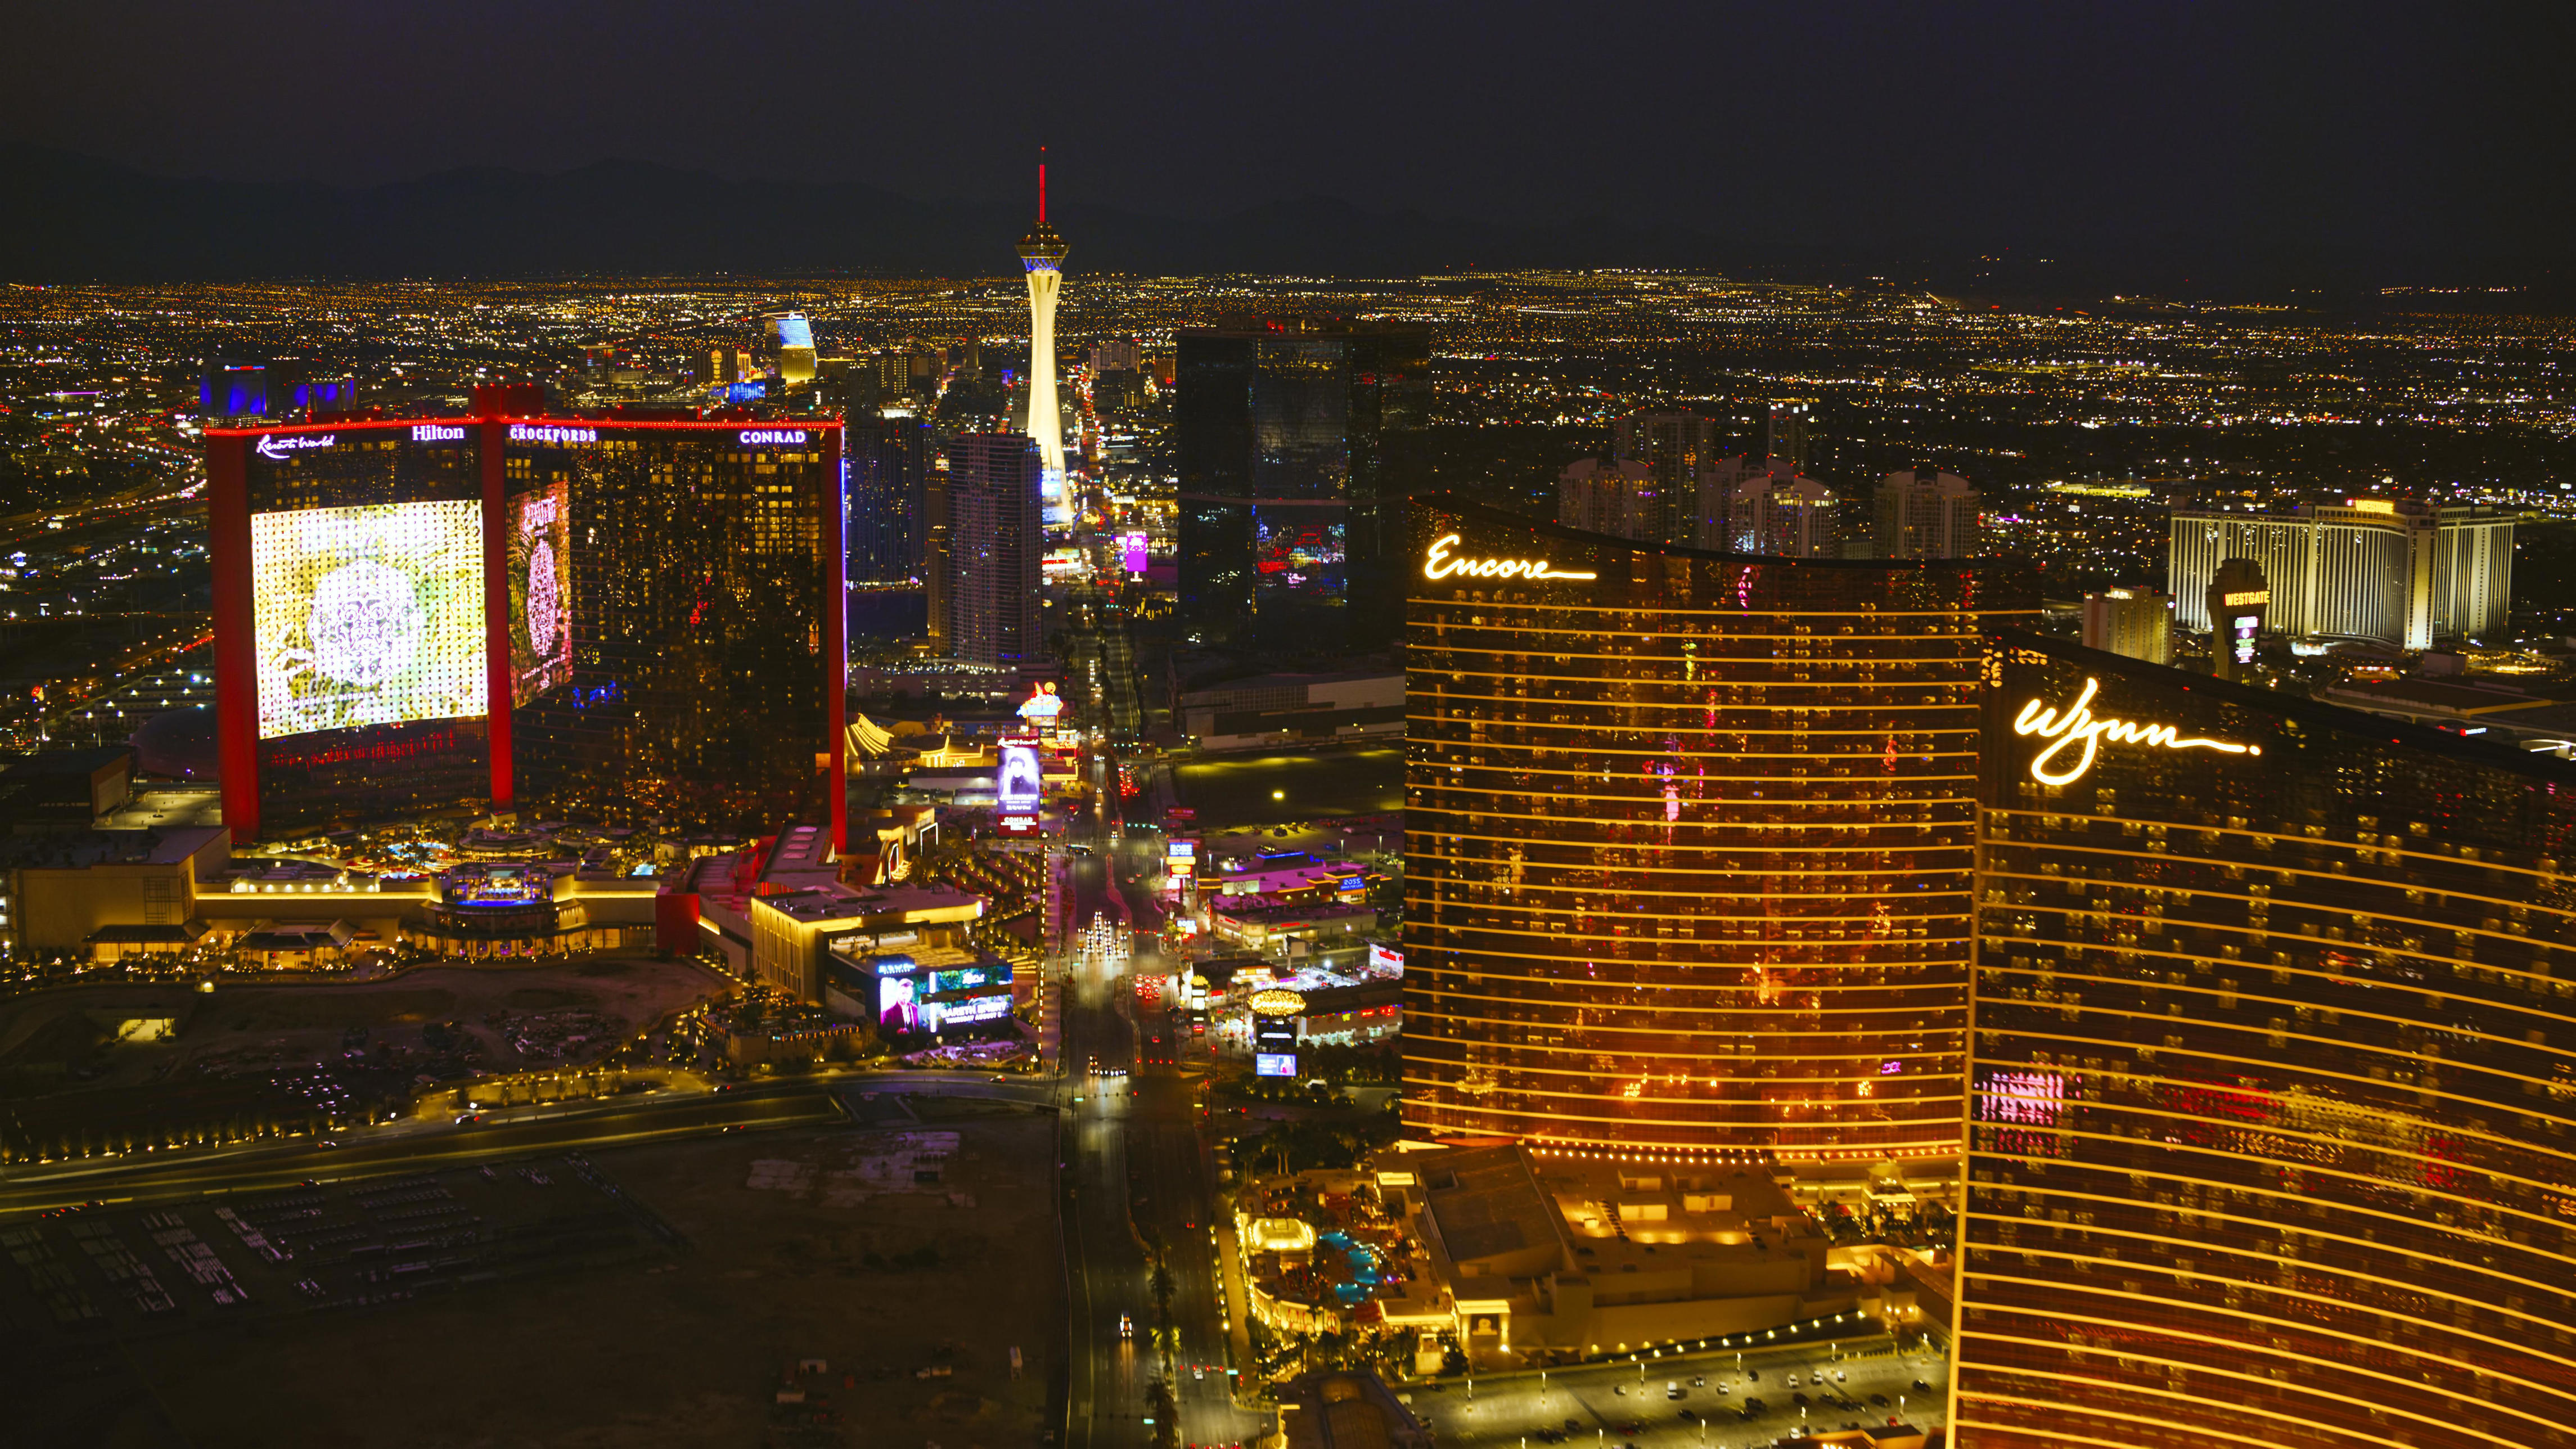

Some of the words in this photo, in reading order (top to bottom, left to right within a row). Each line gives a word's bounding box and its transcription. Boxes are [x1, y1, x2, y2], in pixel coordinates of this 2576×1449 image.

[412, 425, 465, 441] Hilton
[510, 428, 597, 442] CROCKFORDS
[740, 430, 806, 444] CONRAD
[256, 434, 298, 460] Resorts
[299, 434, 335, 449] World
[1425, 534, 1597, 579] Encore
[2224, 591, 2271, 606] WESTGATE
[1170, 844, 1192, 852] ROSS
[1251, 993, 1305, 1010] Encore
